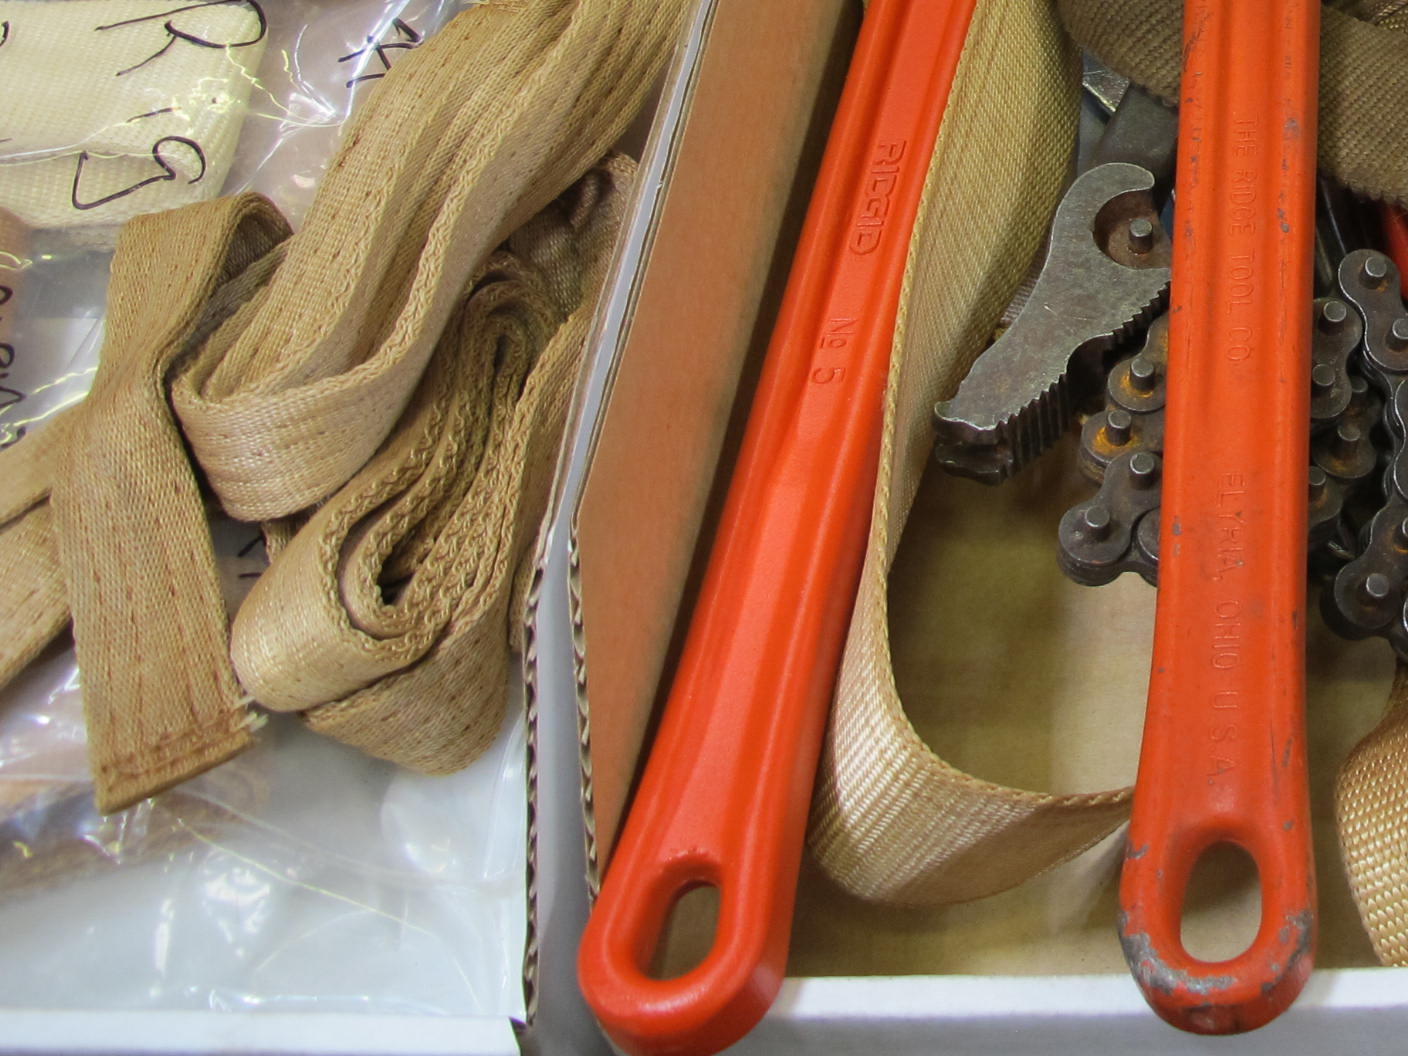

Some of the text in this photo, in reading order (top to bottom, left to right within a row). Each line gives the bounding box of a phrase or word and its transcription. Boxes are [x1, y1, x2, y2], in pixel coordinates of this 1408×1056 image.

[1231, 116, 1260, 160] THE
[850, 140, 908, 256] RIDGID
[1229, 169, 1257, 237] RIDGE
[1226, 248, 1257, 316] TOOL
[811, 367, 847, 385] 5
[1210, 598, 1243, 671] OHIO
